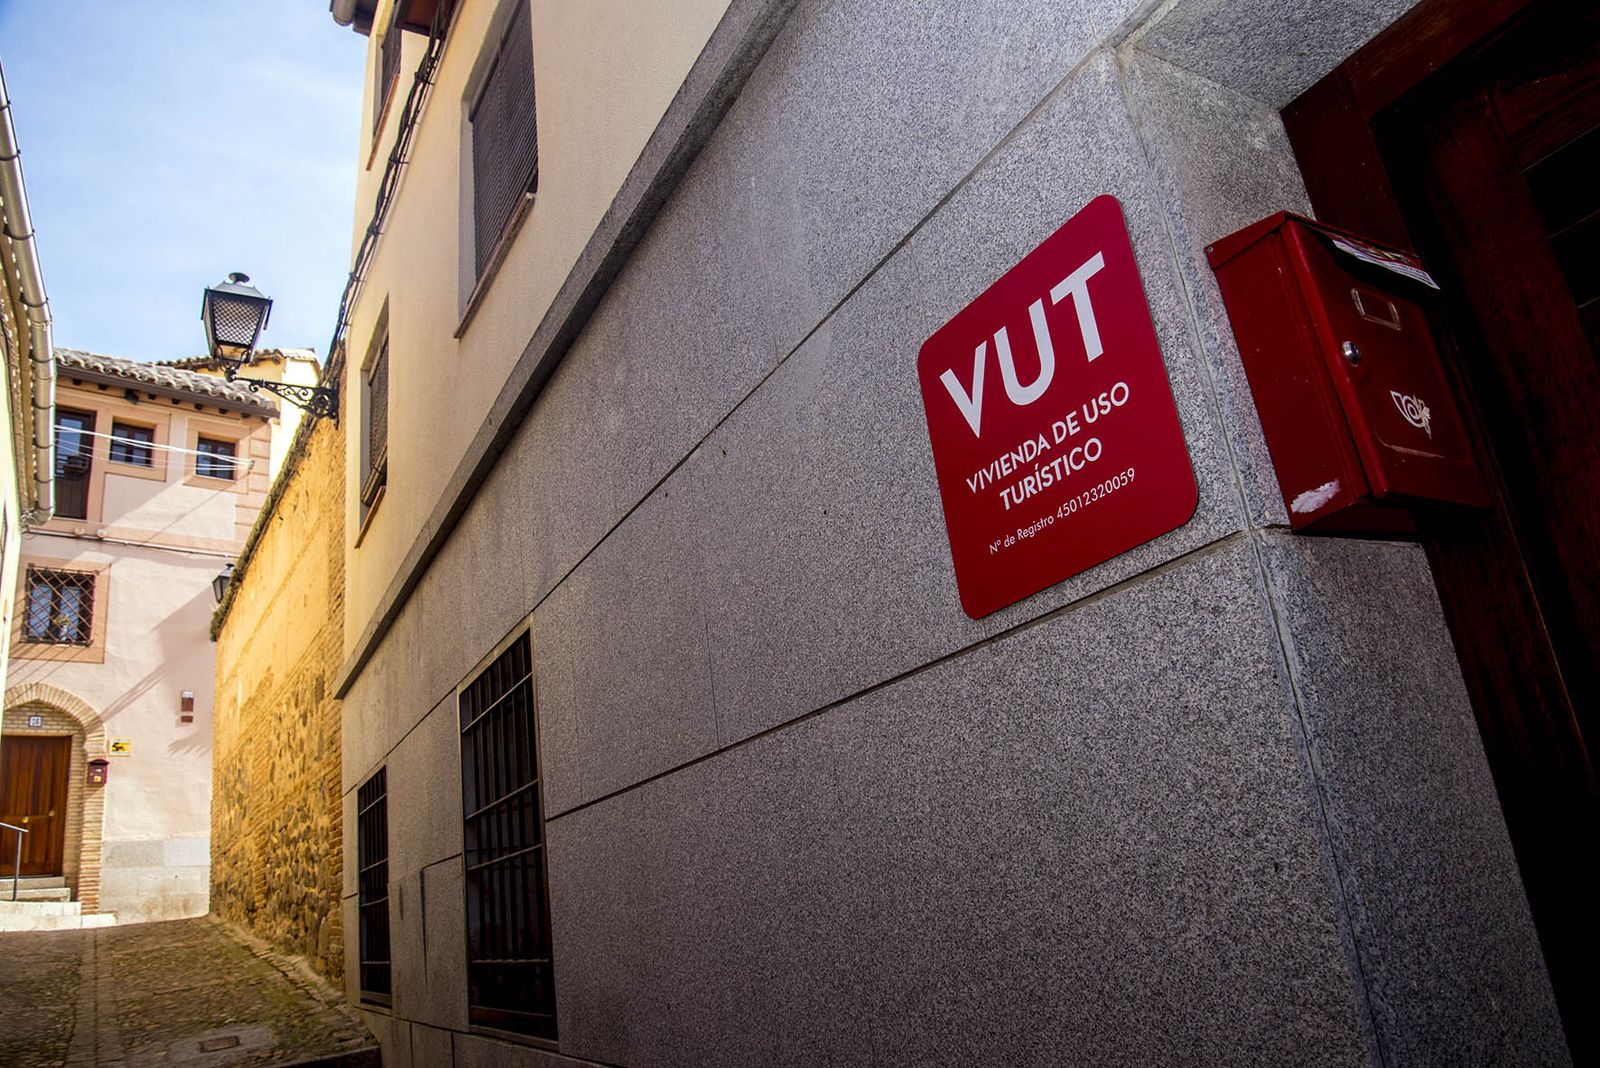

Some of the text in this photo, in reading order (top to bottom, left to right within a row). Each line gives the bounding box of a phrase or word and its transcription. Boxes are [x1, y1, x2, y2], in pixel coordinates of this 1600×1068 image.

[940, 251, 1106, 438] VUT
[966, 382, 1130, 494] VIVIENDA DE USO
[999, 437, 1103, 511] TURÍSTICO
[1003, 534, 1016, 549] de
[1016, 515, 1055, 541] Registro
[1056, 467, 1135, 519] 45012320059
